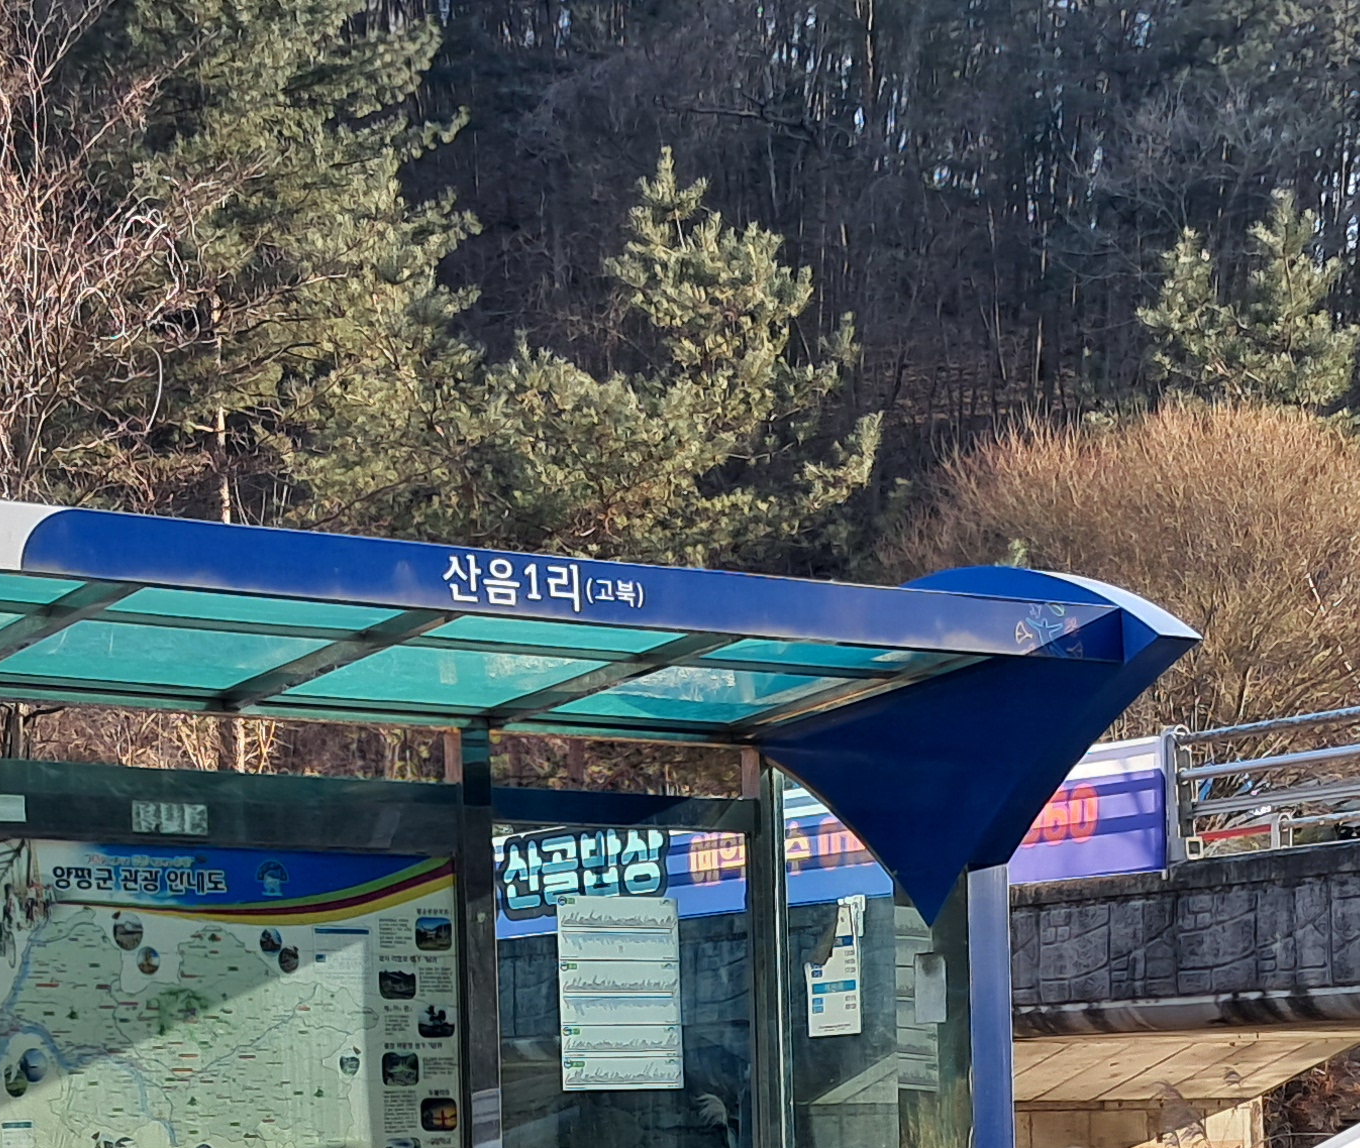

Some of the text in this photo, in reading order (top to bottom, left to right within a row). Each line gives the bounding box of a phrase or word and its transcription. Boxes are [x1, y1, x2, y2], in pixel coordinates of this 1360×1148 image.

[442, 554, 646, 612] 산음1리 (고북)
[52, 865, 228, 895] 양평군 관광 안내도
[503, 828, 664, 910] 산골밥상
